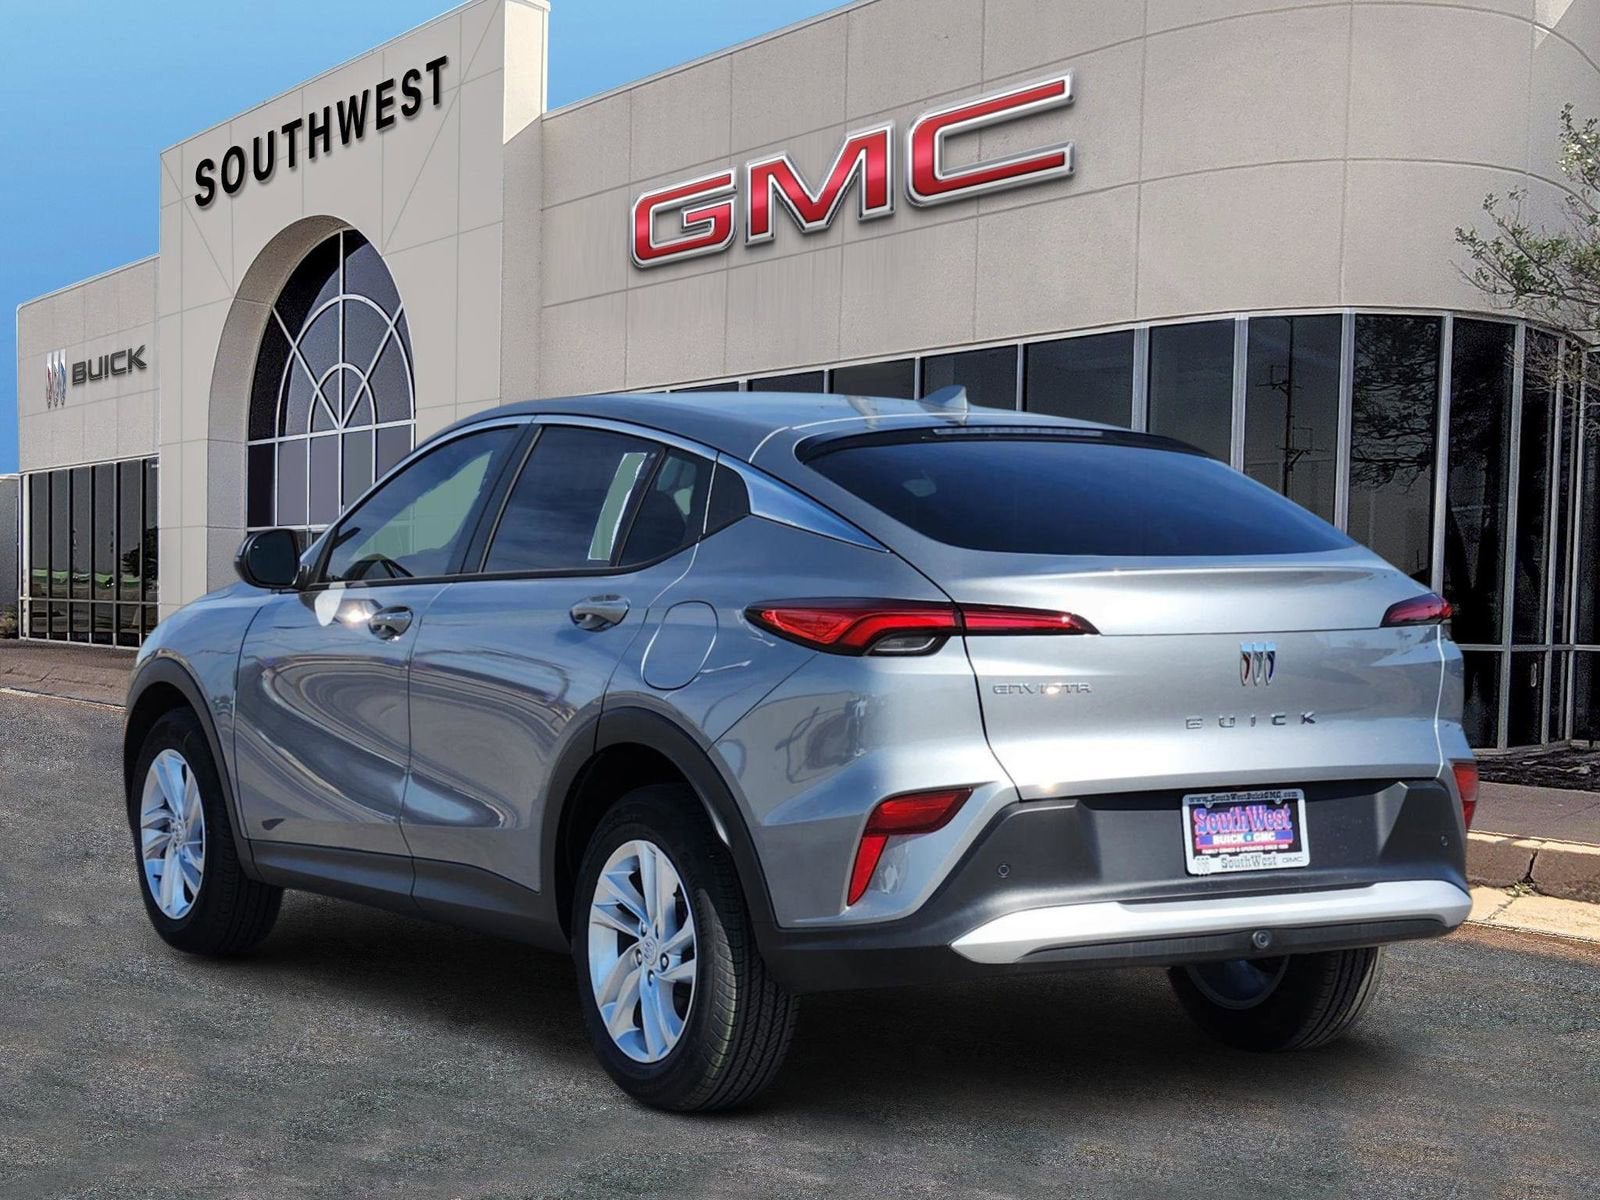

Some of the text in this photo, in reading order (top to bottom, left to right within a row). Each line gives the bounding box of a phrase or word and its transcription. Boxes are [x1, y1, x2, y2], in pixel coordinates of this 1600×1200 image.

[194, 55, 448, 208] SOUTHWEST
[629, 69, 1076, 270] GMC
[72, 344, 147, 386] BUICK
[1185, 711, 1317, 731] BUICK
[1213, 831, 1276, 845] BUICK GMC
[1282, 856, 1303, 864] GMC
